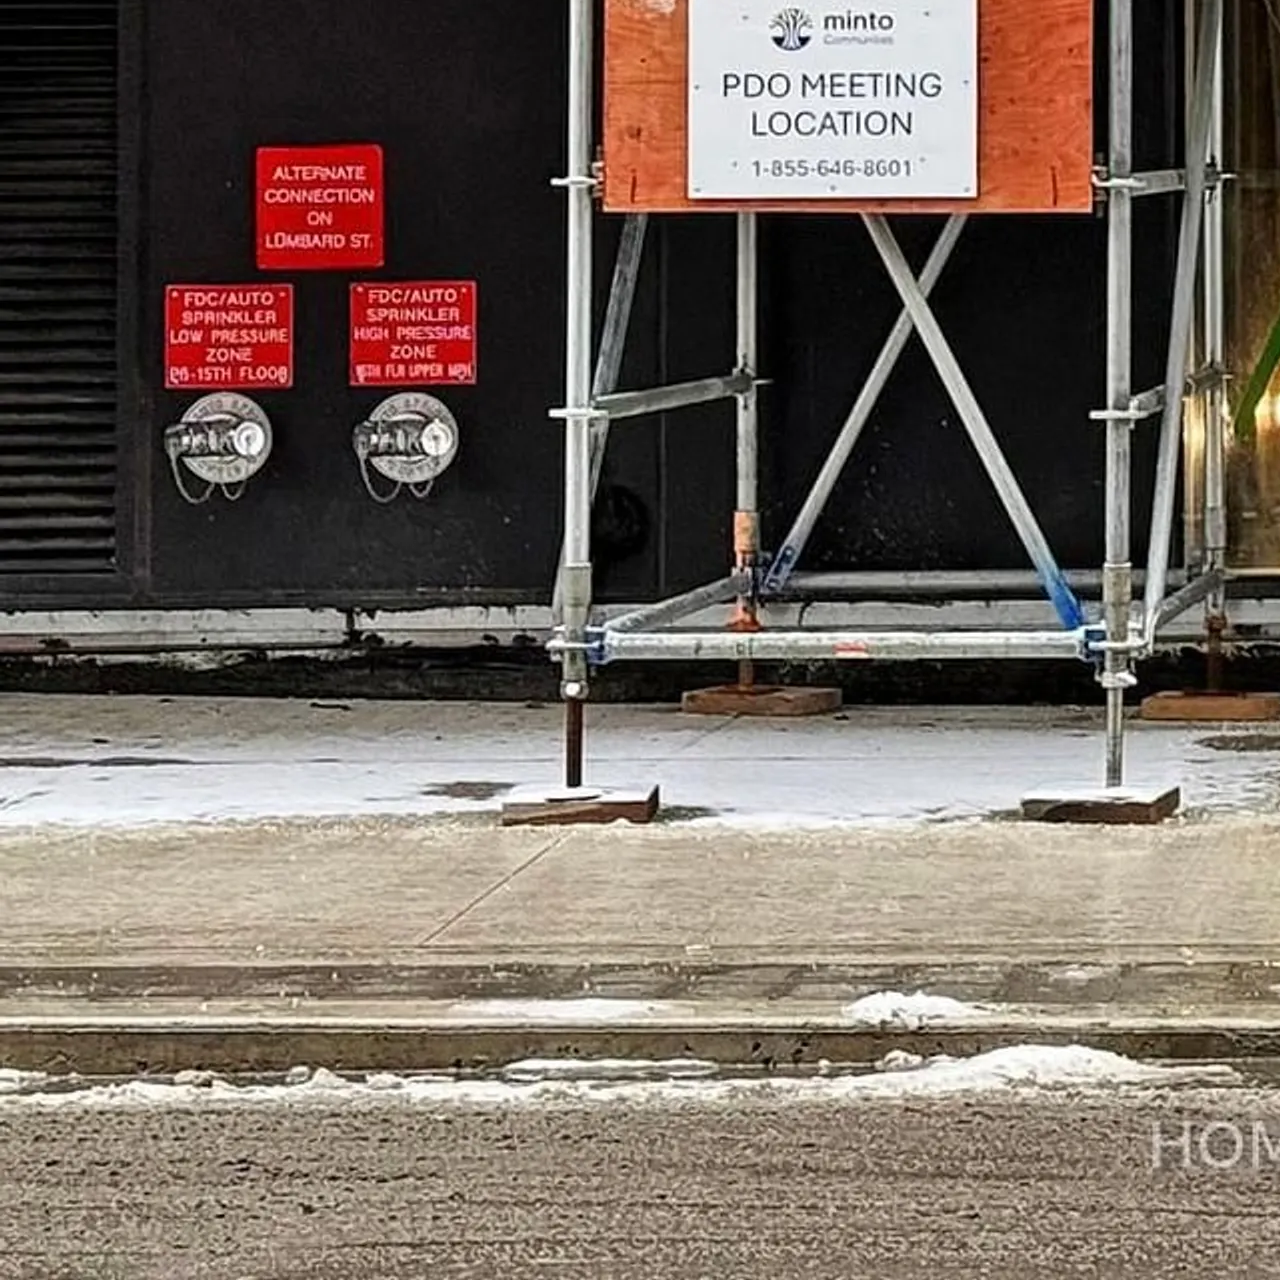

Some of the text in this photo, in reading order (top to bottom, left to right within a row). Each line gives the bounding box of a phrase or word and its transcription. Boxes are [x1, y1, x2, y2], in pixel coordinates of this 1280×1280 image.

[823, 9, 894, 31] minto
[722, 73, 943, 98] PDO MEETING
[752, 111, 912, 136] LOCATION
[273, 166, 366, 180] ALTERNATE
[264, 188, 375, 204] CONNECTION
[307, 211, 333, 225] ON
[265, 233, 346, 249] LOMBARD
[184, 292, 274, 307] FDC/AUTO
[368, 288, 458, 304] FDC/AUTO
[182, 310, 277, 326] SPRINKLER
[366, 308, 460, 322] SPRINKLER
[170, 328, 288, 344] LOW PRESSURE
[354, 325, 471, 341] HIGH PRESSURE
[205, 348, 253, 362] ZONE
[389, 344, 437, 359] ZONE
